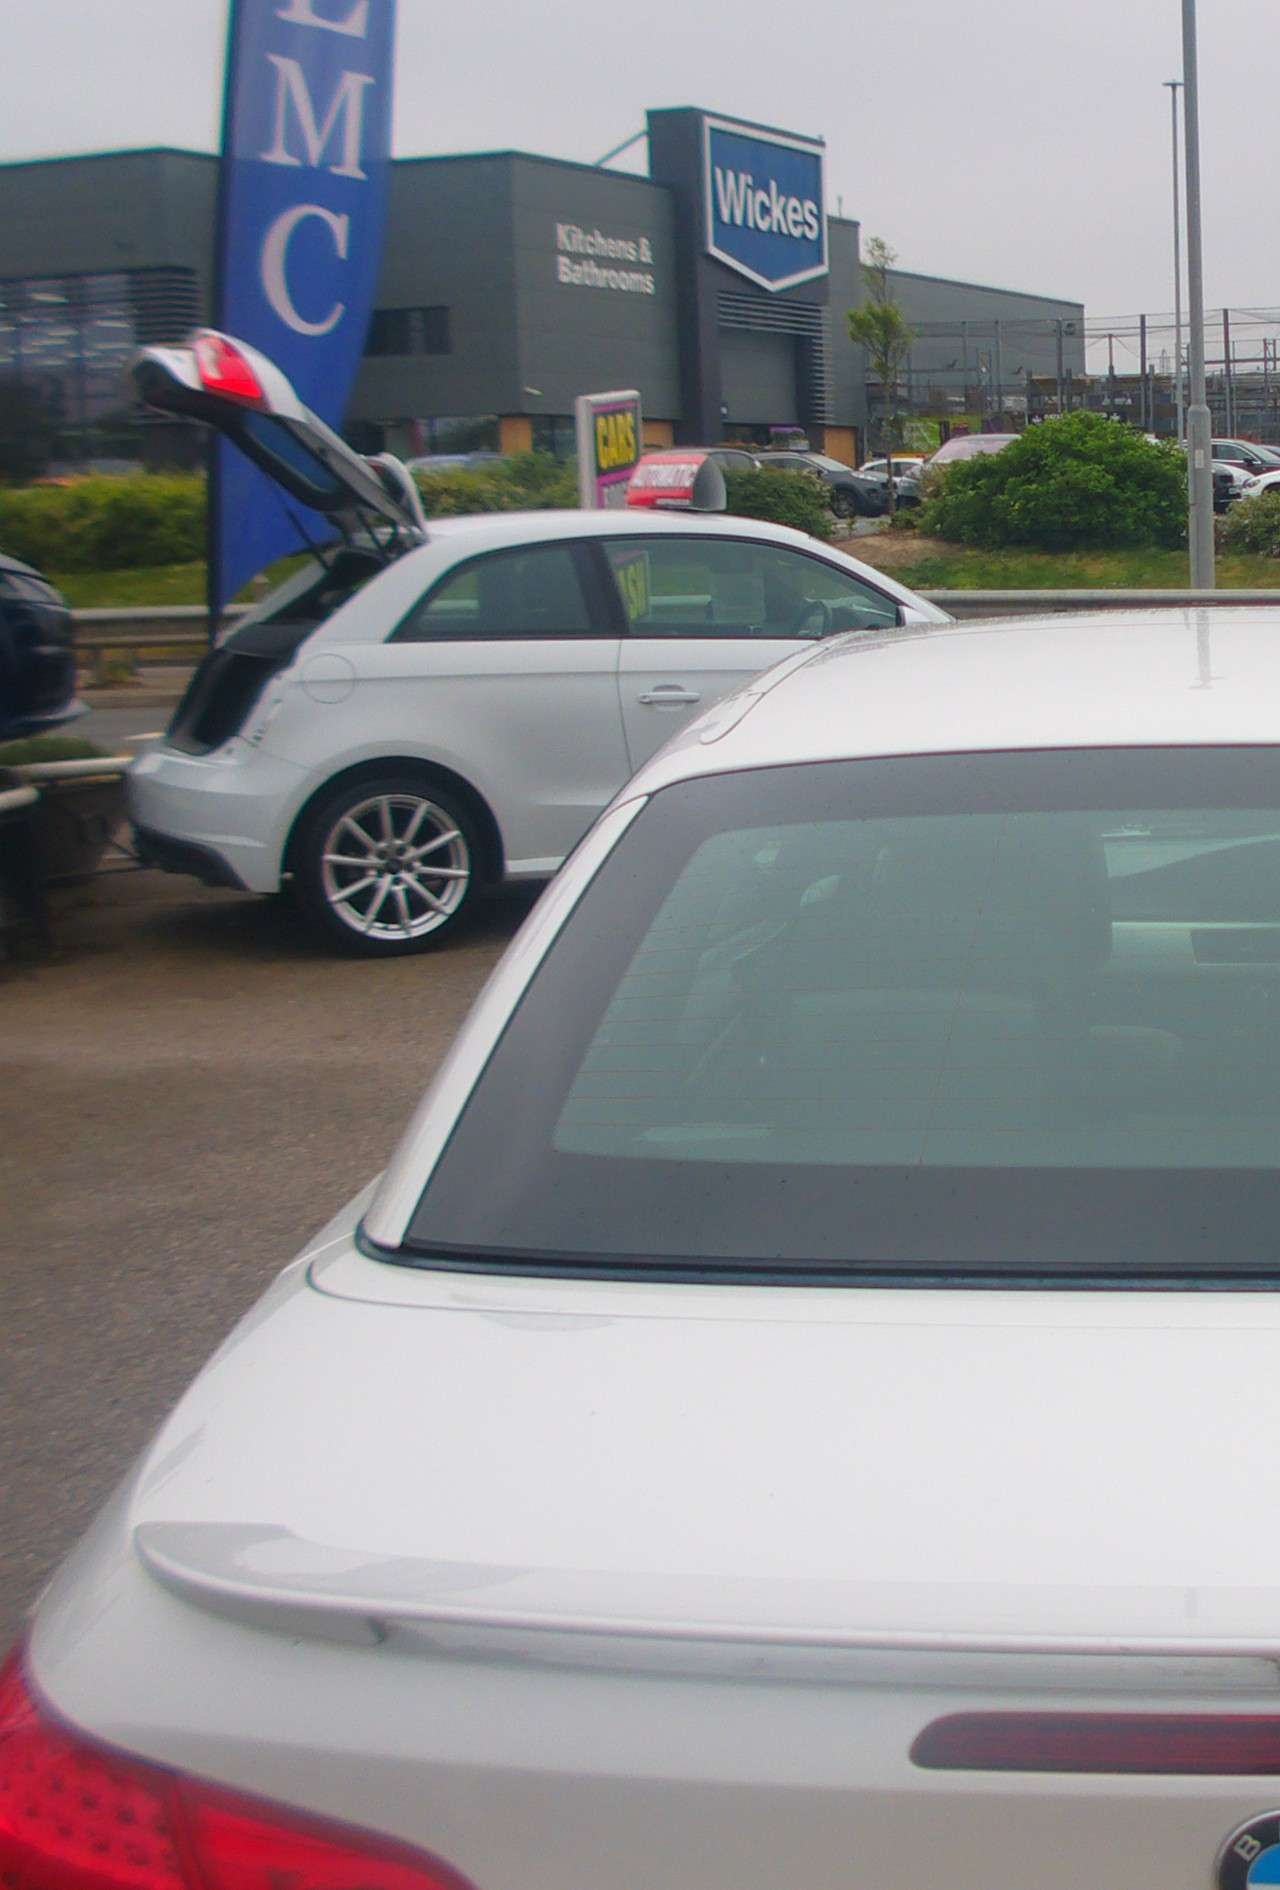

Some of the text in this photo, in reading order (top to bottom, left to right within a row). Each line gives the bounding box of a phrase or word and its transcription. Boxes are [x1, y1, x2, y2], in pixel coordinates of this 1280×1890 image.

[715, 166, 820, 241] Wickes
[556, 222, 654, 264] Kitchens &
[557, 255, 655, 294] Bathrooms
[596, 411, 638, 471] CARS
